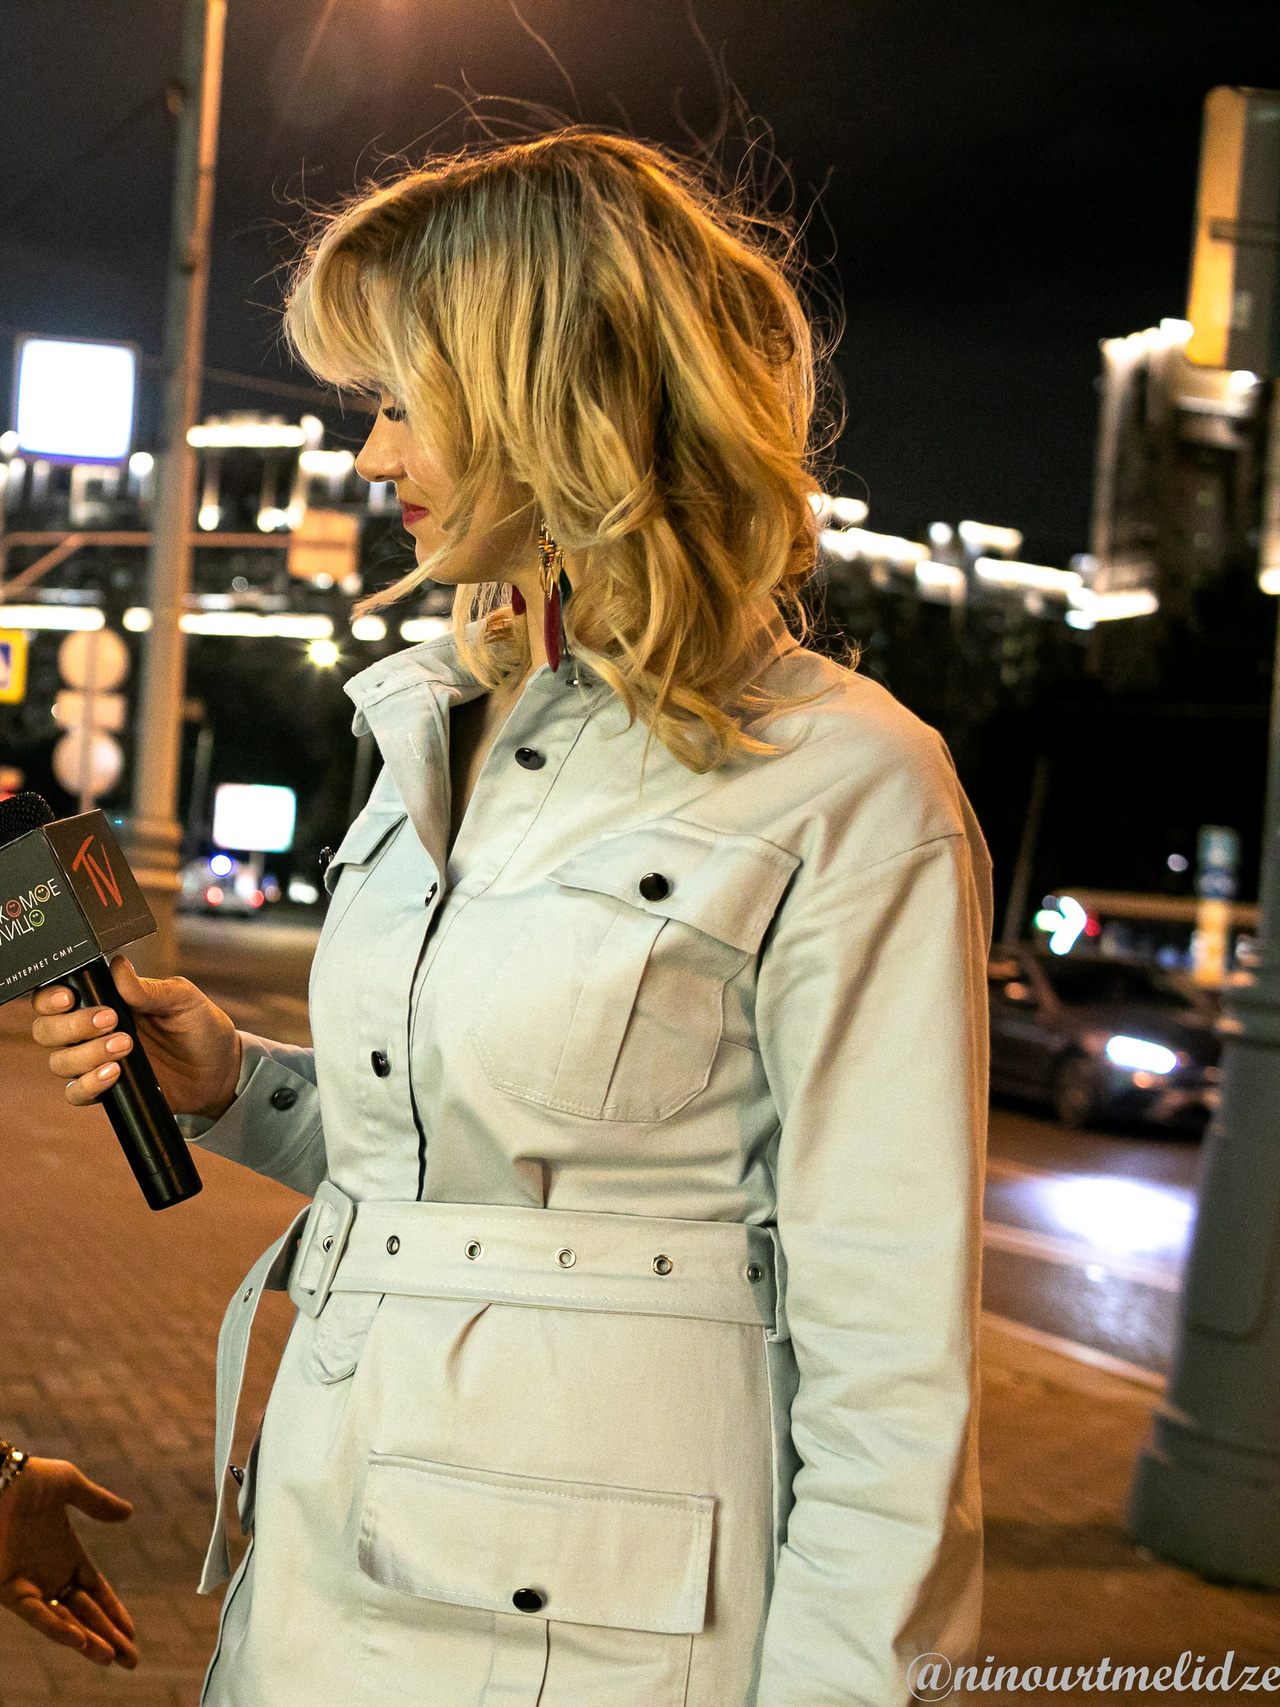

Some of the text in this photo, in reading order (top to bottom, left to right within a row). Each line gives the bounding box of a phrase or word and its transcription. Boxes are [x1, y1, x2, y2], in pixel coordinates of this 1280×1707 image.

[72, 834, 123, 907] TV
[6, 946, 74, 985] ИНТЕРНЕТ СМИ
